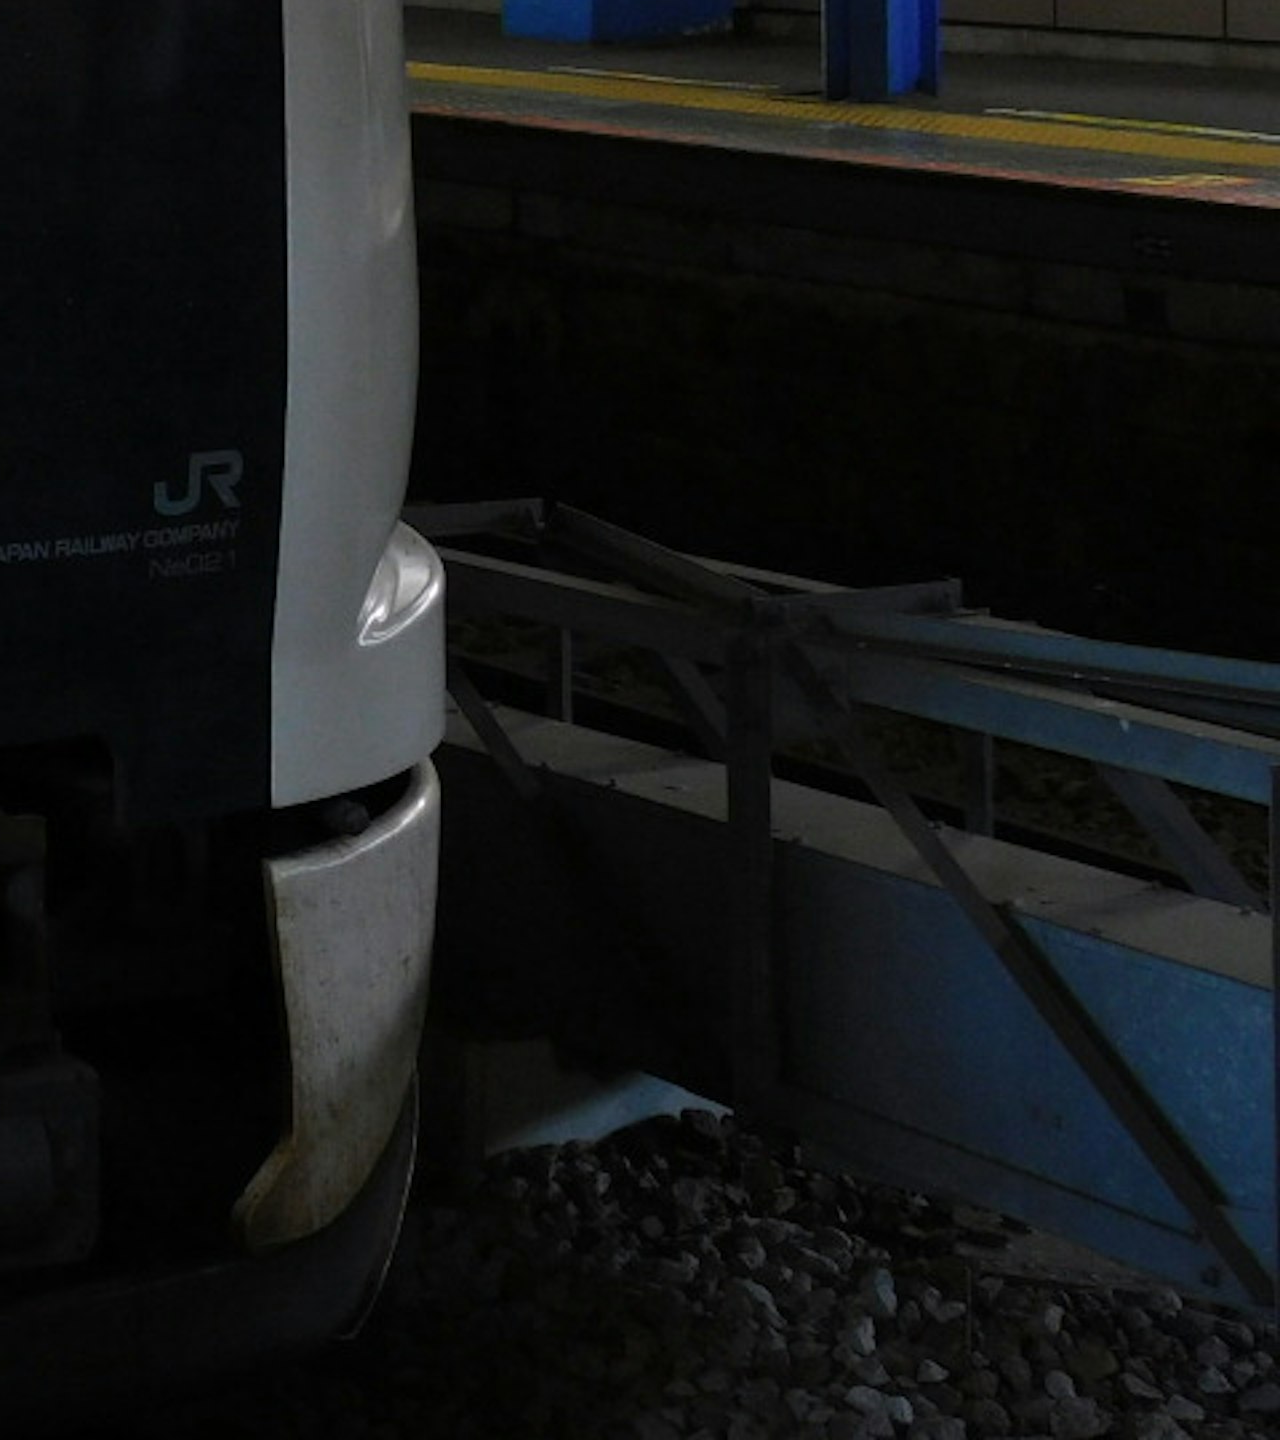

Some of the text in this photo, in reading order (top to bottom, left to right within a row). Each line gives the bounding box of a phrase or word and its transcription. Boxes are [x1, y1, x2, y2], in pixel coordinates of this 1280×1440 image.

[153, 449, 244, 516] JR
[54, 529, 142, 559] RAILWAY
[143, 520, 240, 549] COMPANY
